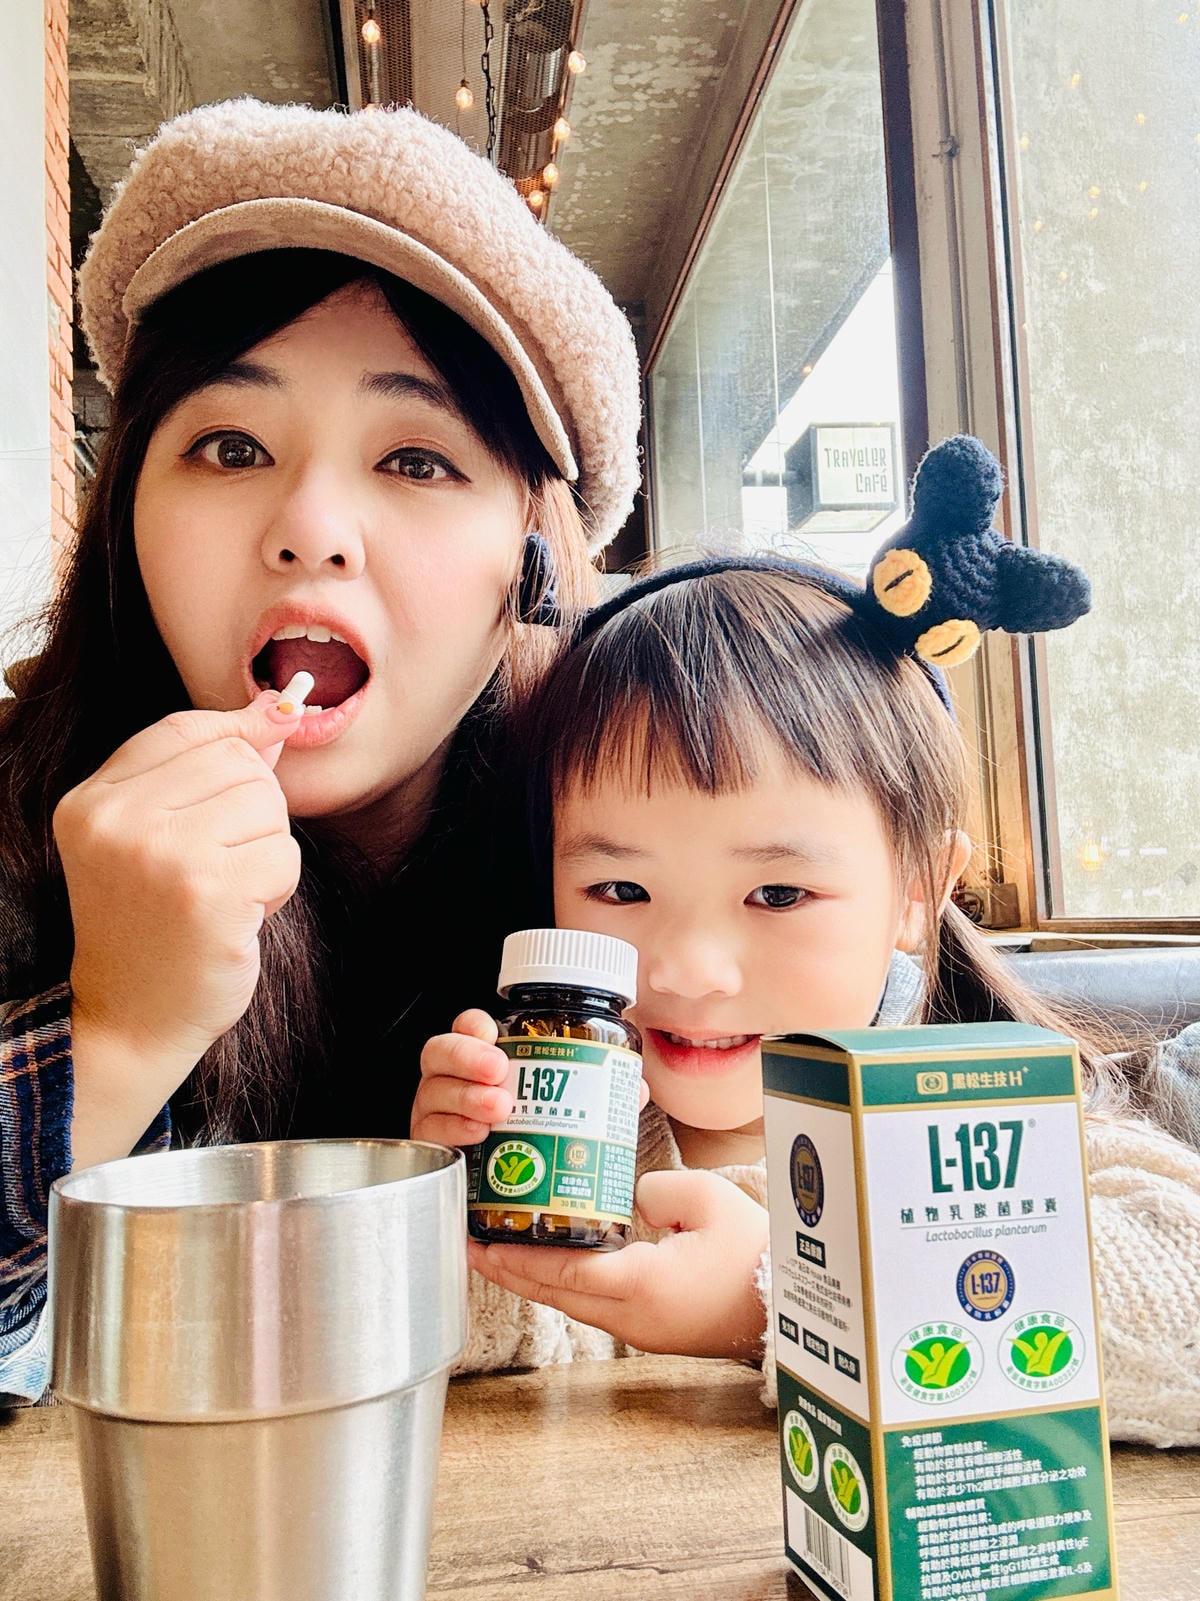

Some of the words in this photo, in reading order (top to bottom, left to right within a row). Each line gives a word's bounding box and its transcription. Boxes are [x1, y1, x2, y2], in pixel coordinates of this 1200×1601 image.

[517, 1067, 570, 1101] L-137
[507, 1118, 544, 1127] Lactobacillus
[928, 1120, 1023, 1193] L-137
[901, 1198, 1057, 1224] 植物乳酸菌膠囊
[926, 1226, 993, 1242] Lactobacillus
[995, 1223, 1047, 1240] plantarum
[971, 1272, 1000, 1295] L-137
[1014, 1313, 1066, 1332] 健康食品
[909, 1324, 963, 1343] 健康食品
